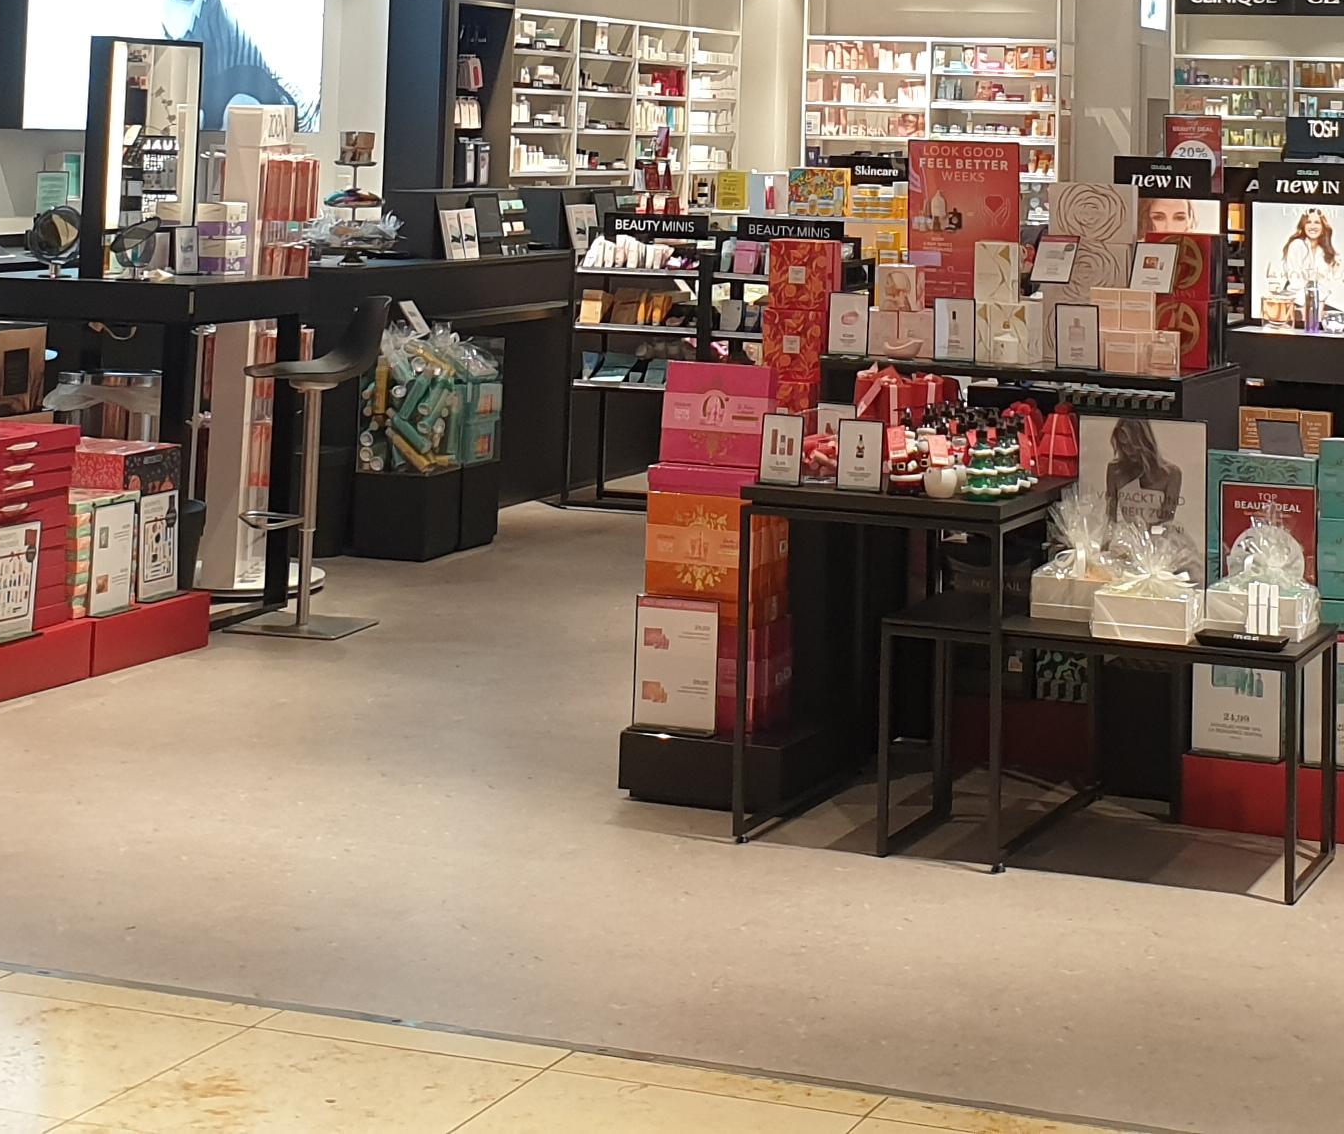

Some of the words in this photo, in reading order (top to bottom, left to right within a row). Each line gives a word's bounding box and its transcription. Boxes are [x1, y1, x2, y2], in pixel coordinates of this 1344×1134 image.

[1308, 119, 1339, 138] TOSH
[923, 145, 959, 157] LOOK
[963, 146, 1005, 158] GOOD
[919, 157, 952, 170] FEEL
[956, 158, 1009, 171] BETTER
[854, 165, 899, 178] Skincare
[941, 171, 985, 183] WEEKS
[1131, 173, 1171, 188] new
[1175, 174, 1192, 189] IN
[1276, 177, 1319, 194] new
[1322, 179, 1341, 195] IN
[615, 219, 660, 232] BEAUTY
[662, 220, 695, 233] MINIS
[748, 224, 795, 237] BEAUTY
[797, 225, 831, 239] MINIS
[1258, 492, 1278, 503] TOP
